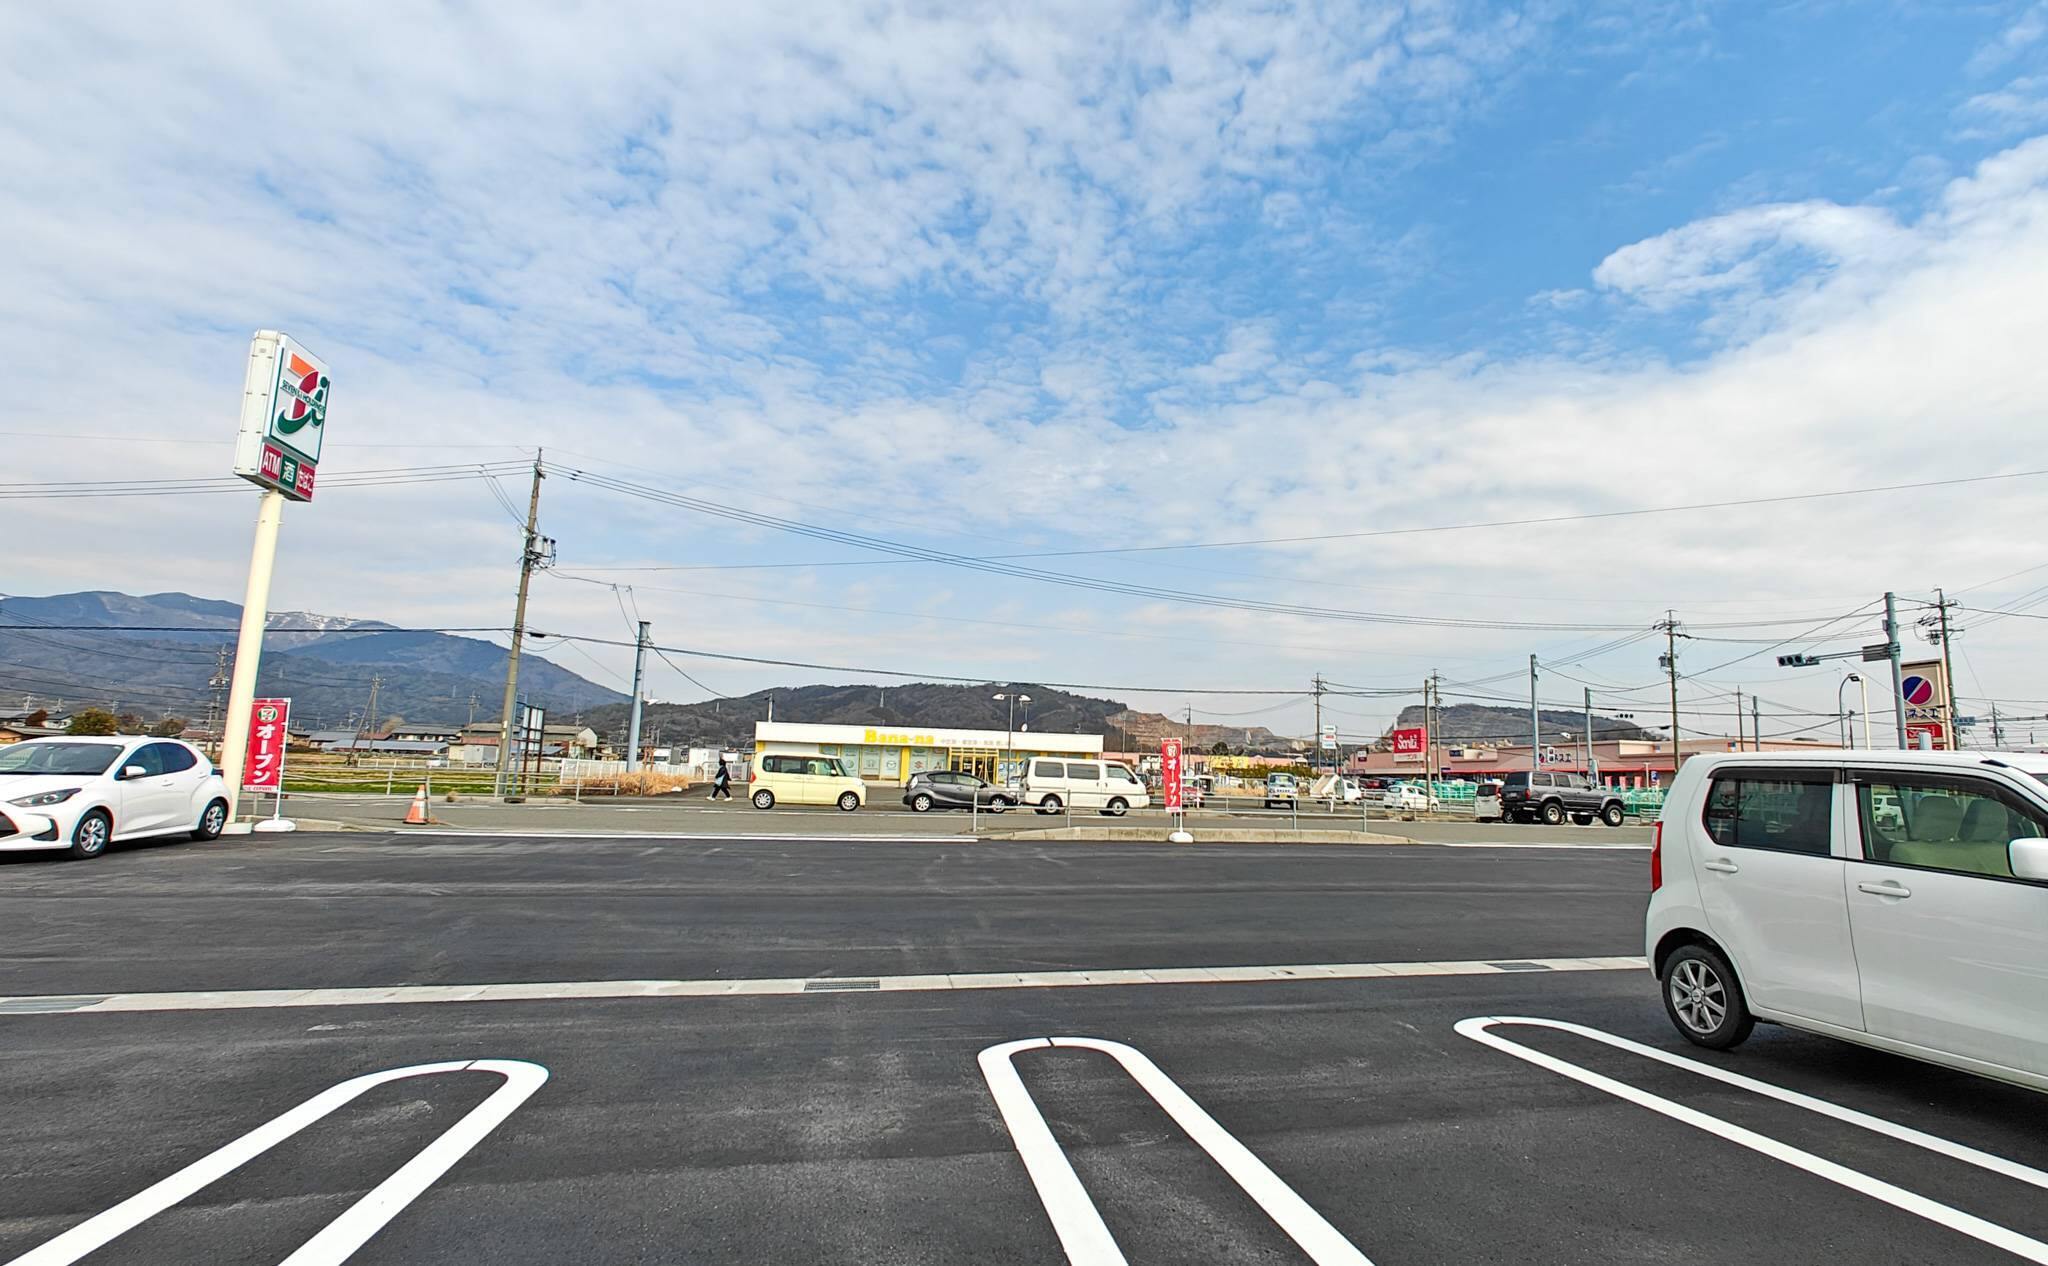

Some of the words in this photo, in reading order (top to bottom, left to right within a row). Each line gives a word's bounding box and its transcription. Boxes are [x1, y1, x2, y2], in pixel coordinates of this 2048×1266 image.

[262, 450, 281, 475] ATM
[282, 460, 296, 483] 酒
[1904, 707, 1940, 719] ネスエ
[864, 728, 934, 744] Bana-na
[253, 724, 276, 784] オープン
[1167, 758, 1177, 807] オープン
